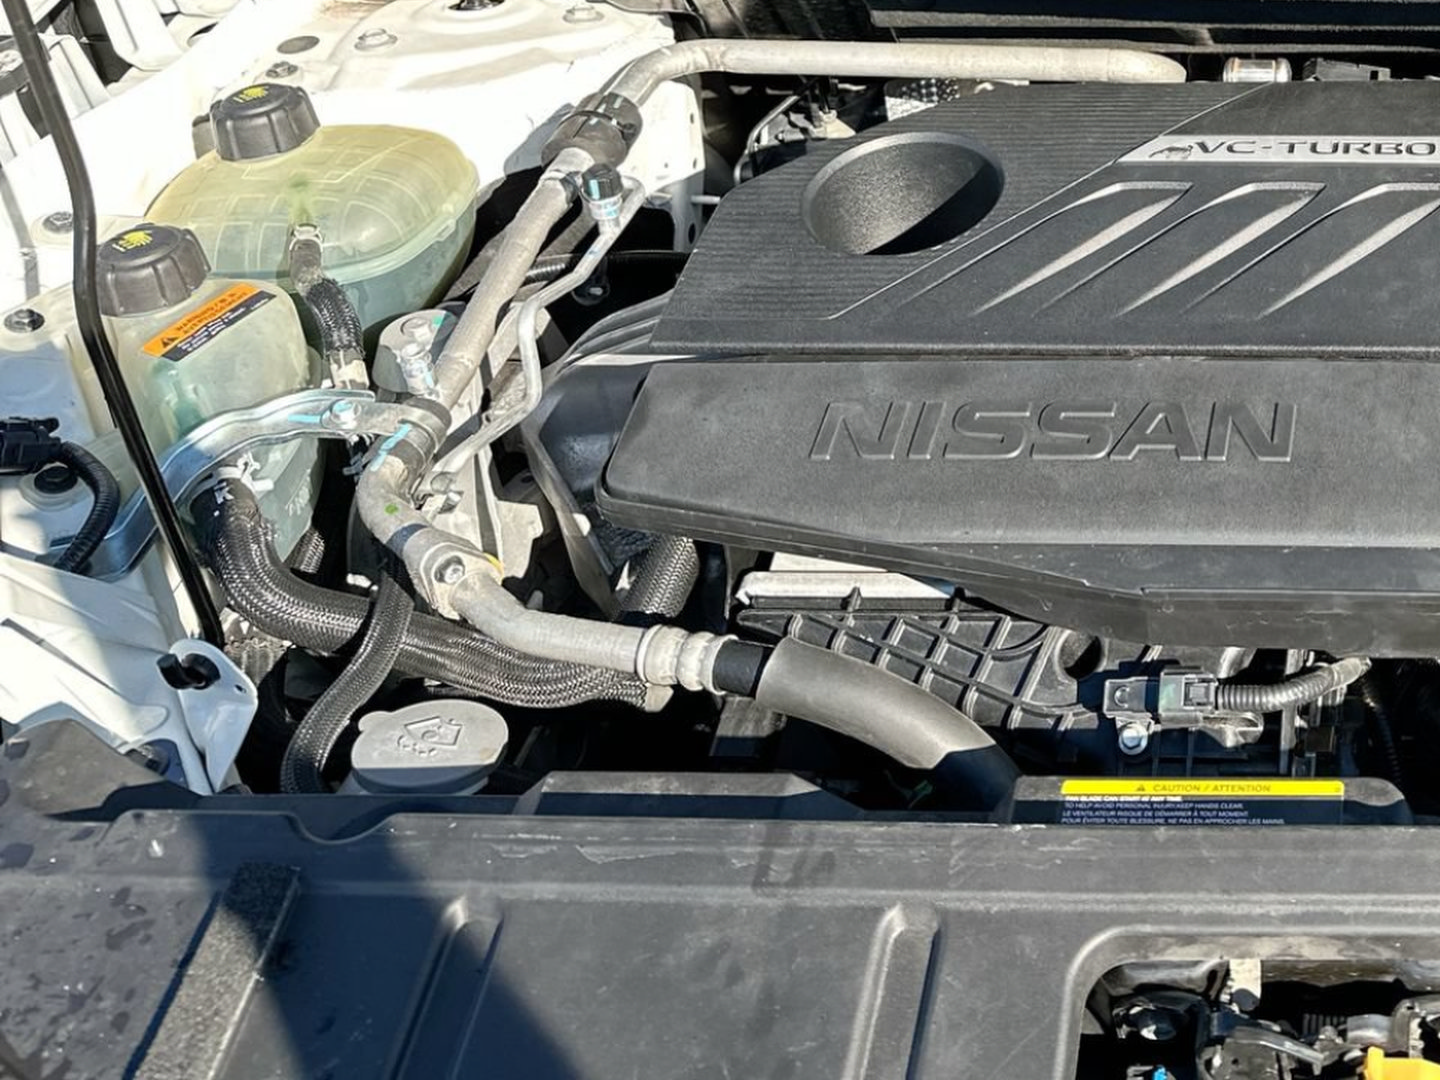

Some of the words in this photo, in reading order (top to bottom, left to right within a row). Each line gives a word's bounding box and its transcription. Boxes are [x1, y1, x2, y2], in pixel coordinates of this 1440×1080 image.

[1194, 140, 1437, 156] VC-TURBO
[808, 400, 1298, 462] NISSAN
[1152, 784, 1200, 792] CAUTION
[1211, 784, 1271, 792] ATTENTION
